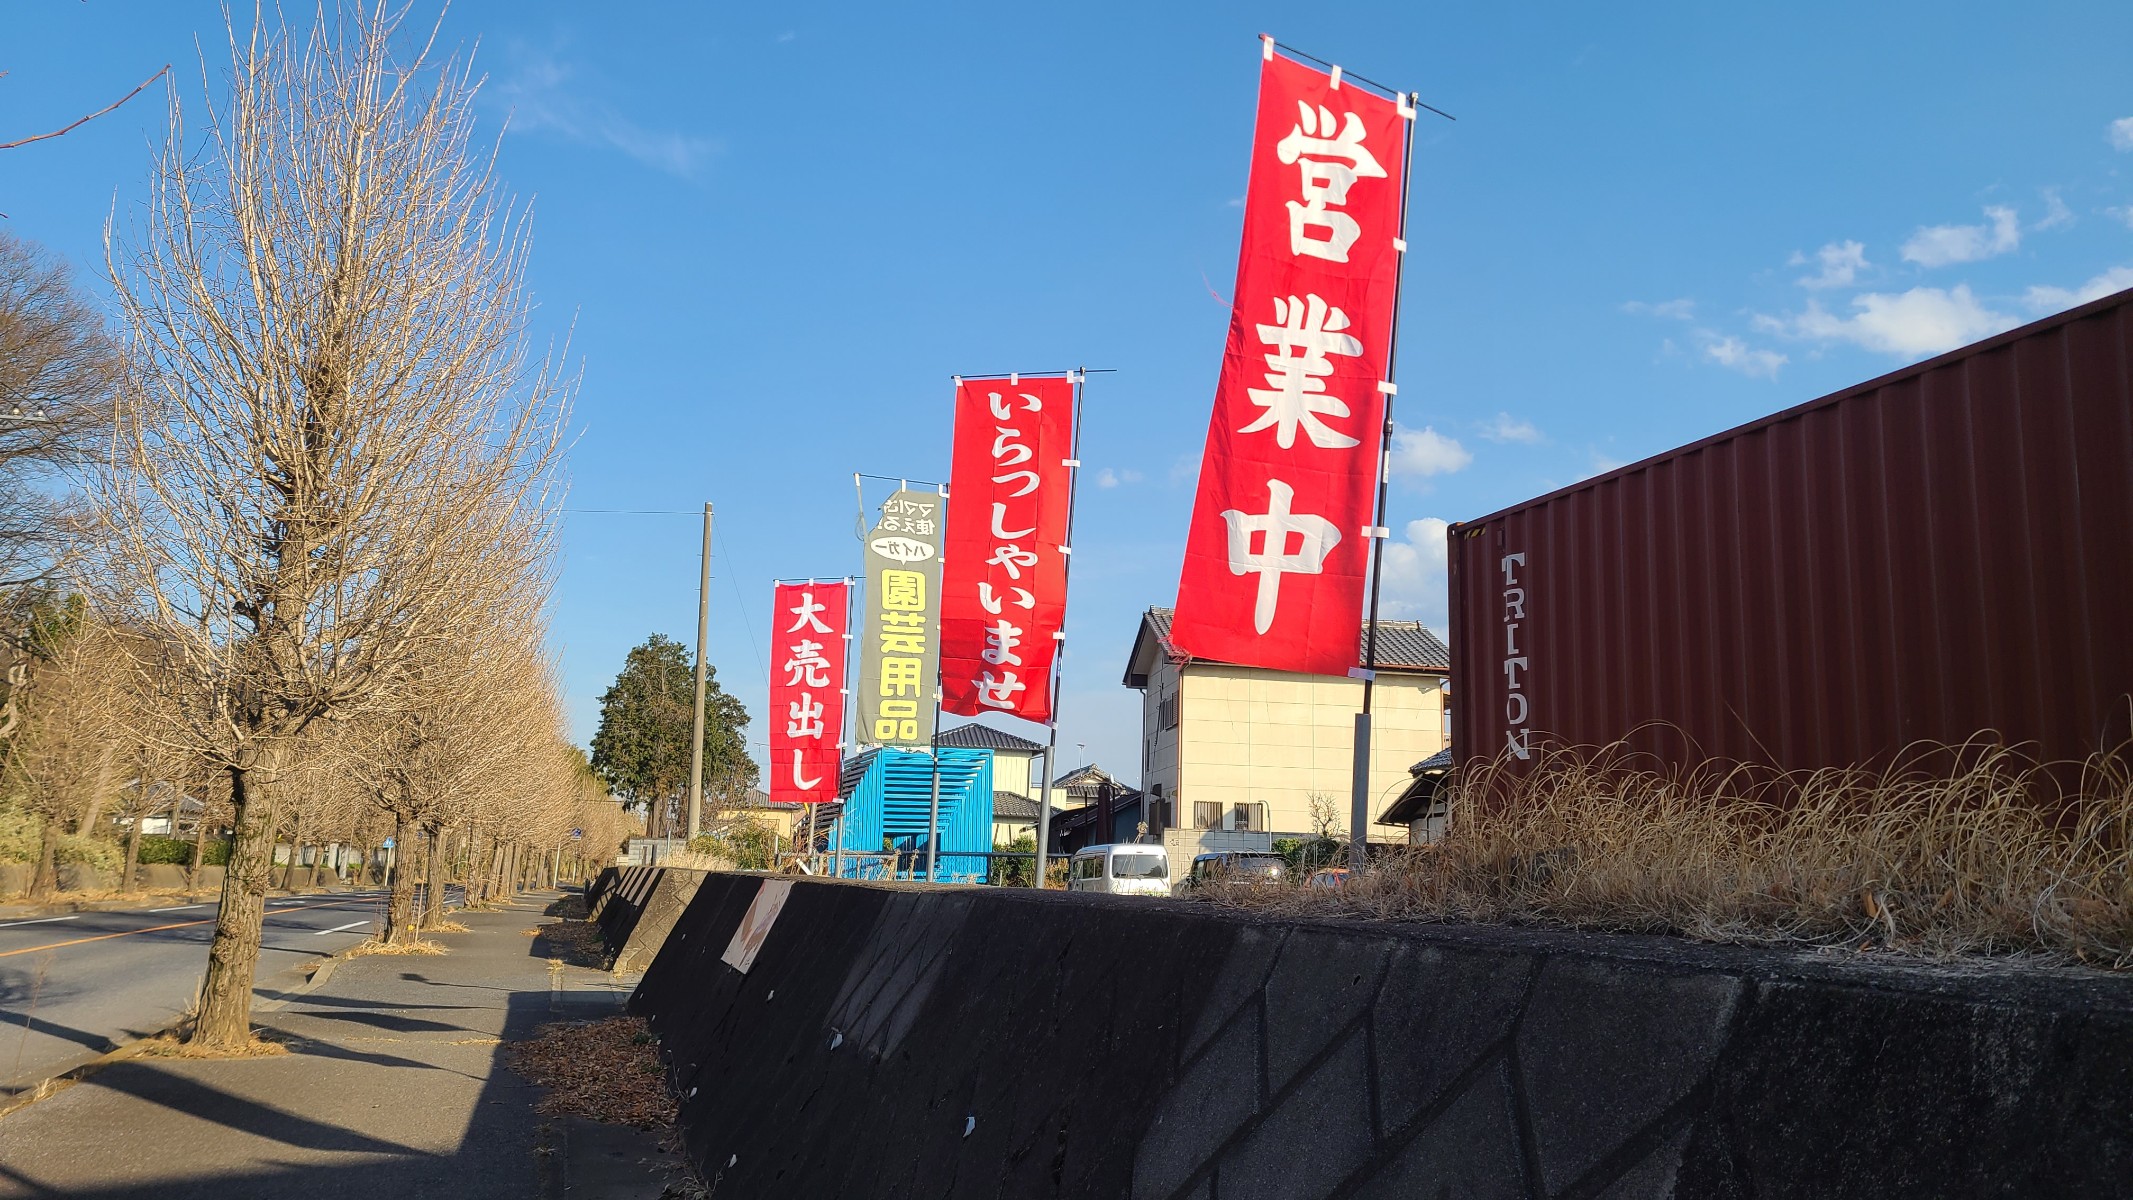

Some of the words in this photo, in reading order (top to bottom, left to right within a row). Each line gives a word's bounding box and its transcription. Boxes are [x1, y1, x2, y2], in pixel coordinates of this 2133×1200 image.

[1219, 99, 1388, 636] 営業中
[784, 592, 834, 791] 大売出し
[1501, 552, 1531, 762] TRITON
